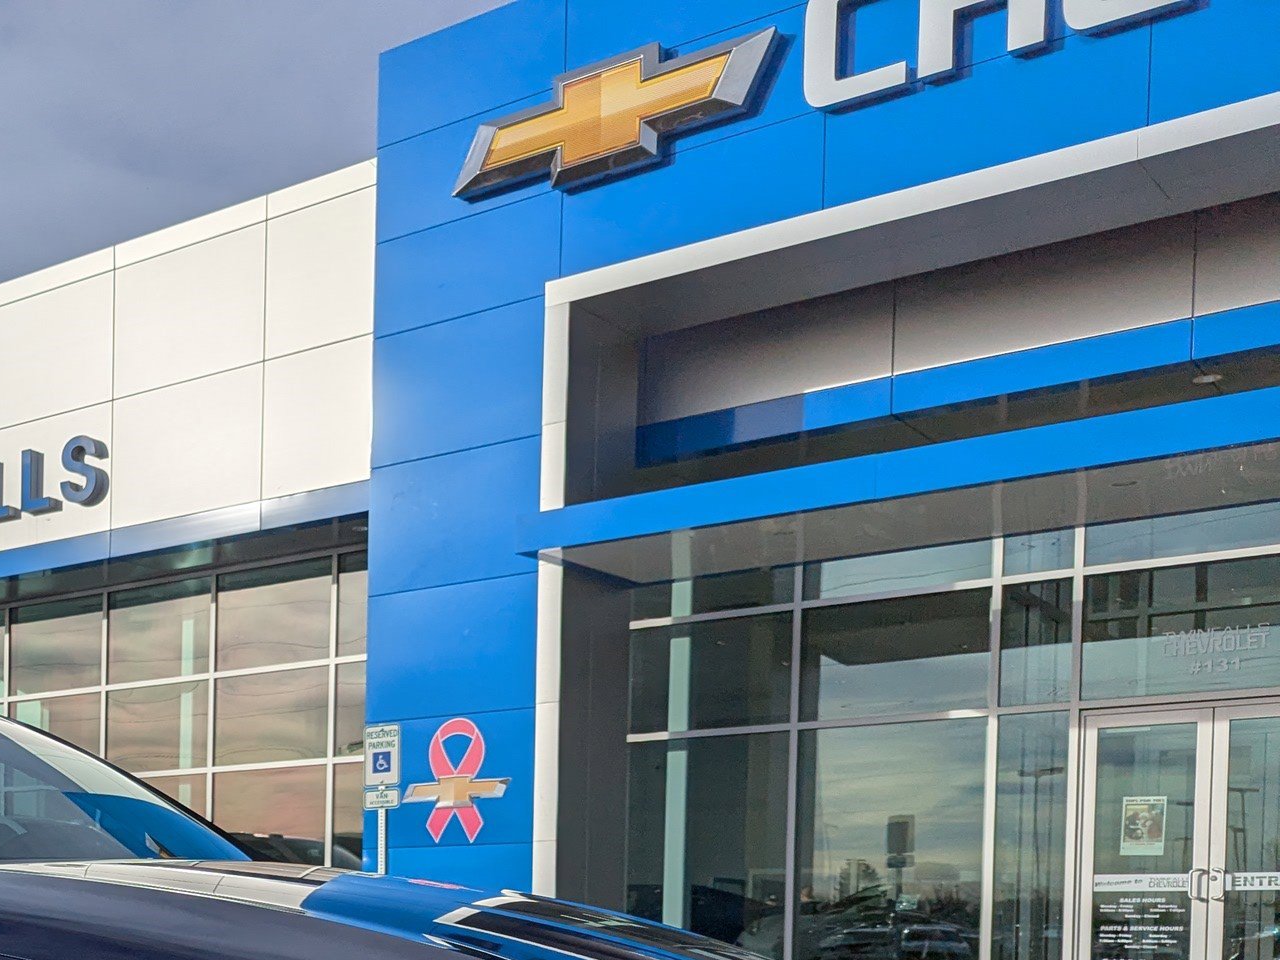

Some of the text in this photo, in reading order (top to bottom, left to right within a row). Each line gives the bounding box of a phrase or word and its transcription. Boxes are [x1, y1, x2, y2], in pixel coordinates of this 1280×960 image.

[803, 0, 1190, 108] CH
[366, 730, 397, 739] RESERVED
[368, 739, 396, 750] PARKING
